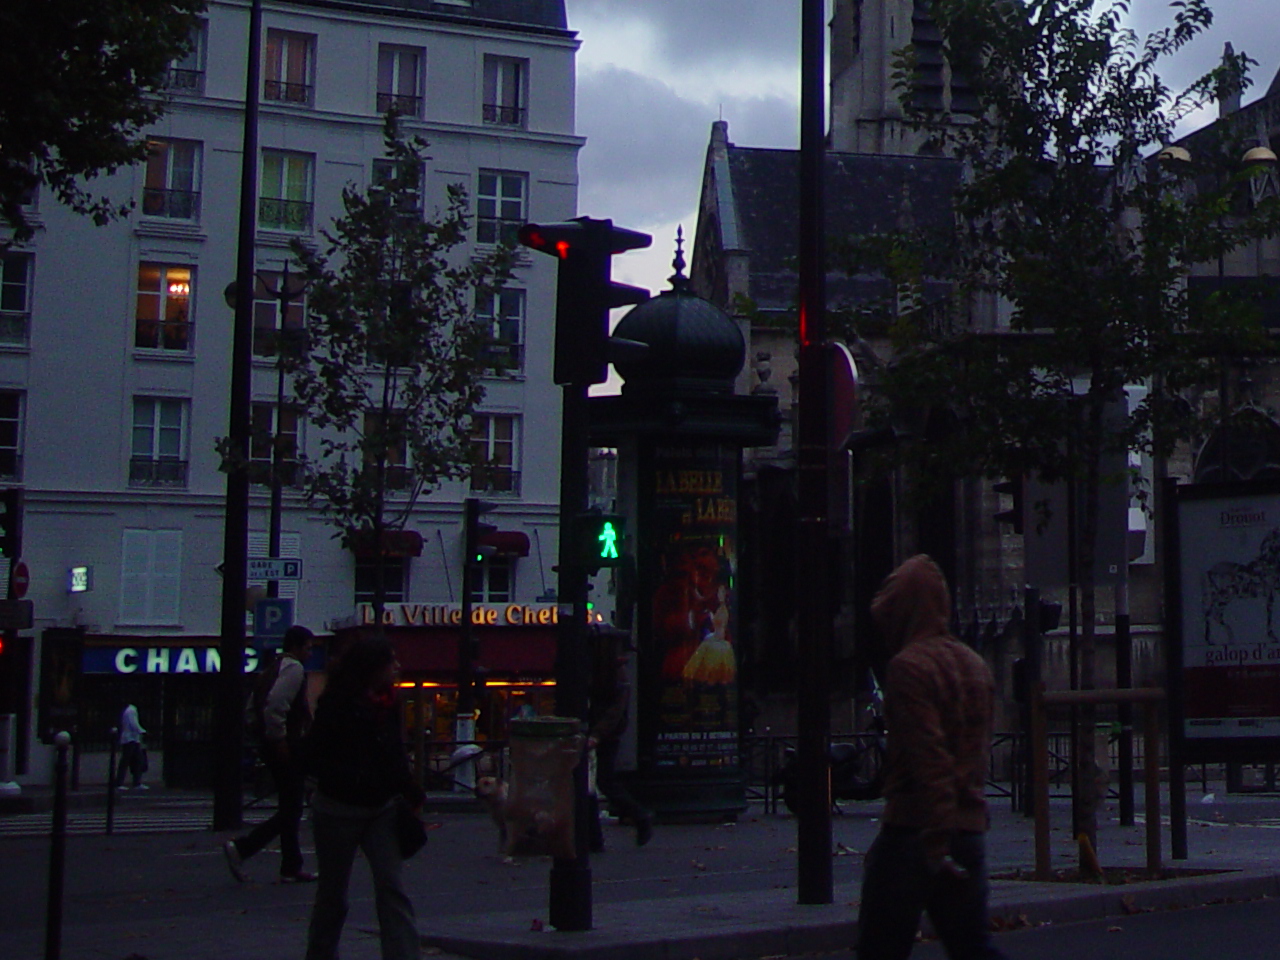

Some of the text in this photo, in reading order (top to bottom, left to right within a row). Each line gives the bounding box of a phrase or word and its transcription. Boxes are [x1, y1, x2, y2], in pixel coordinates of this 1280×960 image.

[678, 471, 722, 493] BELLE
[265, 606, 282, 629] P
[400, 604, 462, 624] Ville
[471, 605, 499, 624] de
[1205, 644, 1249, 666] galop
